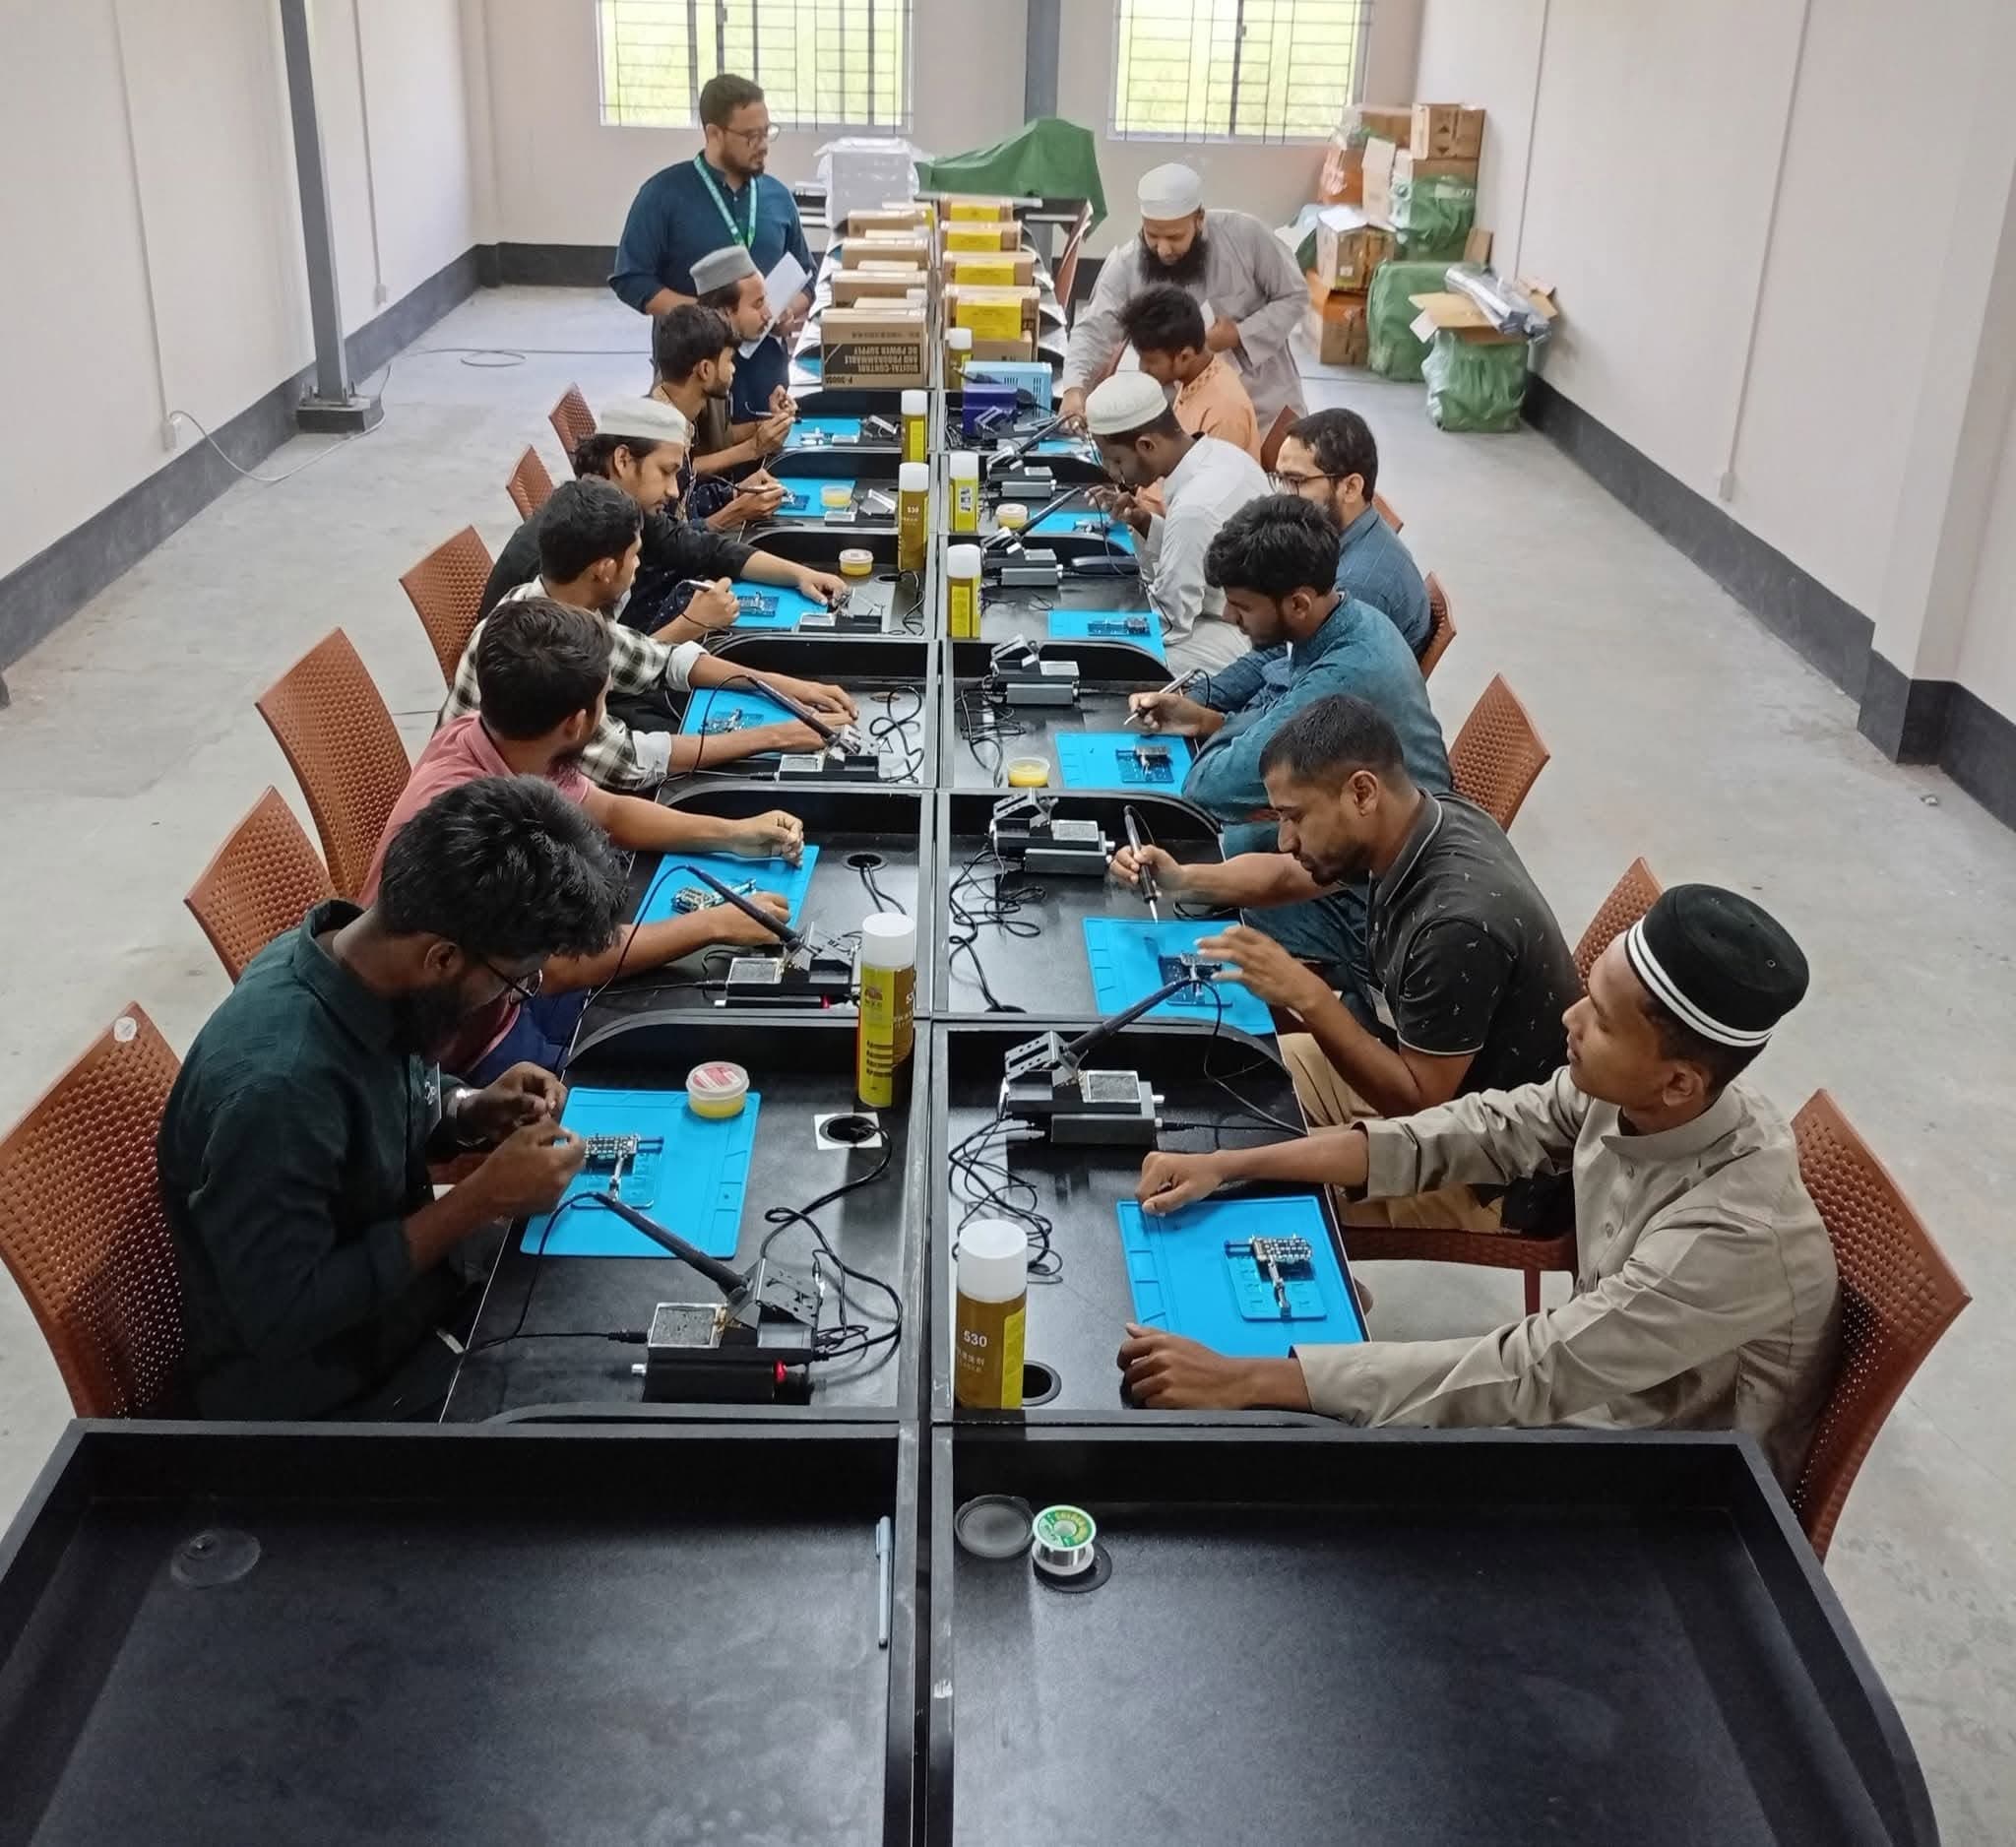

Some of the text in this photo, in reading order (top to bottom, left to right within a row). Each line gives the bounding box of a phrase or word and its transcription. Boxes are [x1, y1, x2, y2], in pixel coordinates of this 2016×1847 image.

[853, 346, 880, 355] SUPPLY
[881, 346, 907, 355] POWER
[964, 1330, 987, 1348] 530
